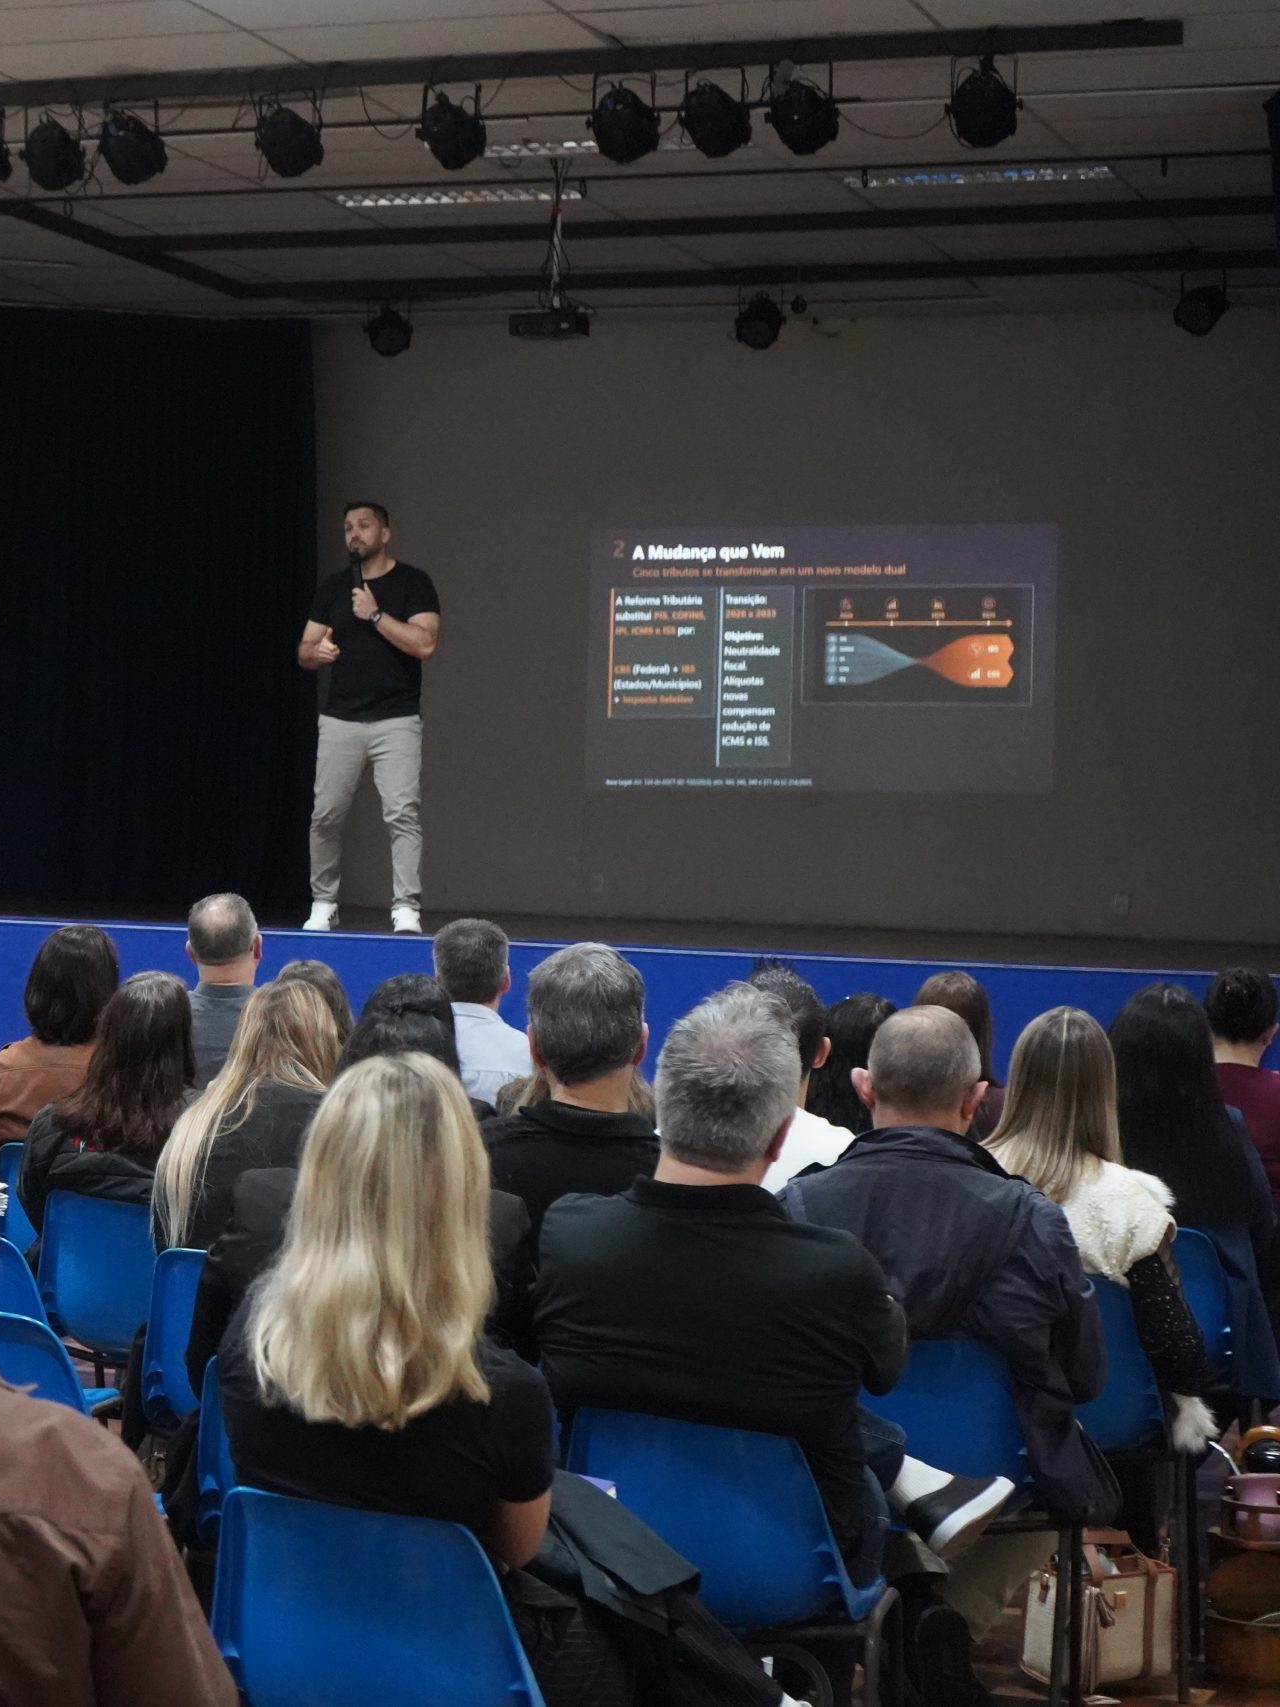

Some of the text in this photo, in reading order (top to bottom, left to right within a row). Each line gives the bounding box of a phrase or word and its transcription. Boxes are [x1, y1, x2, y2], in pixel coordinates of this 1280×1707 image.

[633, 545, 645, 560] A
[648, 544, 716, 563] Mudança
[719, 547, 749, 562] que
[751, 543, 785, 558] Vem
[633, 563, 906, 577] Cinco tributos se transformam em um novo modelo dual
[615, 594, 703, 606] A Reforma Tributária
[725, 594, 768, 607] Transição:
[724, 631, 764, 643] Objetivo:
[724, 645, 781, 657] Neutralidade
[632, 664, 670, 676] (Federal)
[723, 675, 765, 688] Alíquotas
[723, 692, 749, 701] novas
[722, 706, 775, 718] compensam
[722, 721, 771, 733] redução de
[722, 736, 745, 747] ICMS
[746, 739, 753, 747] e
